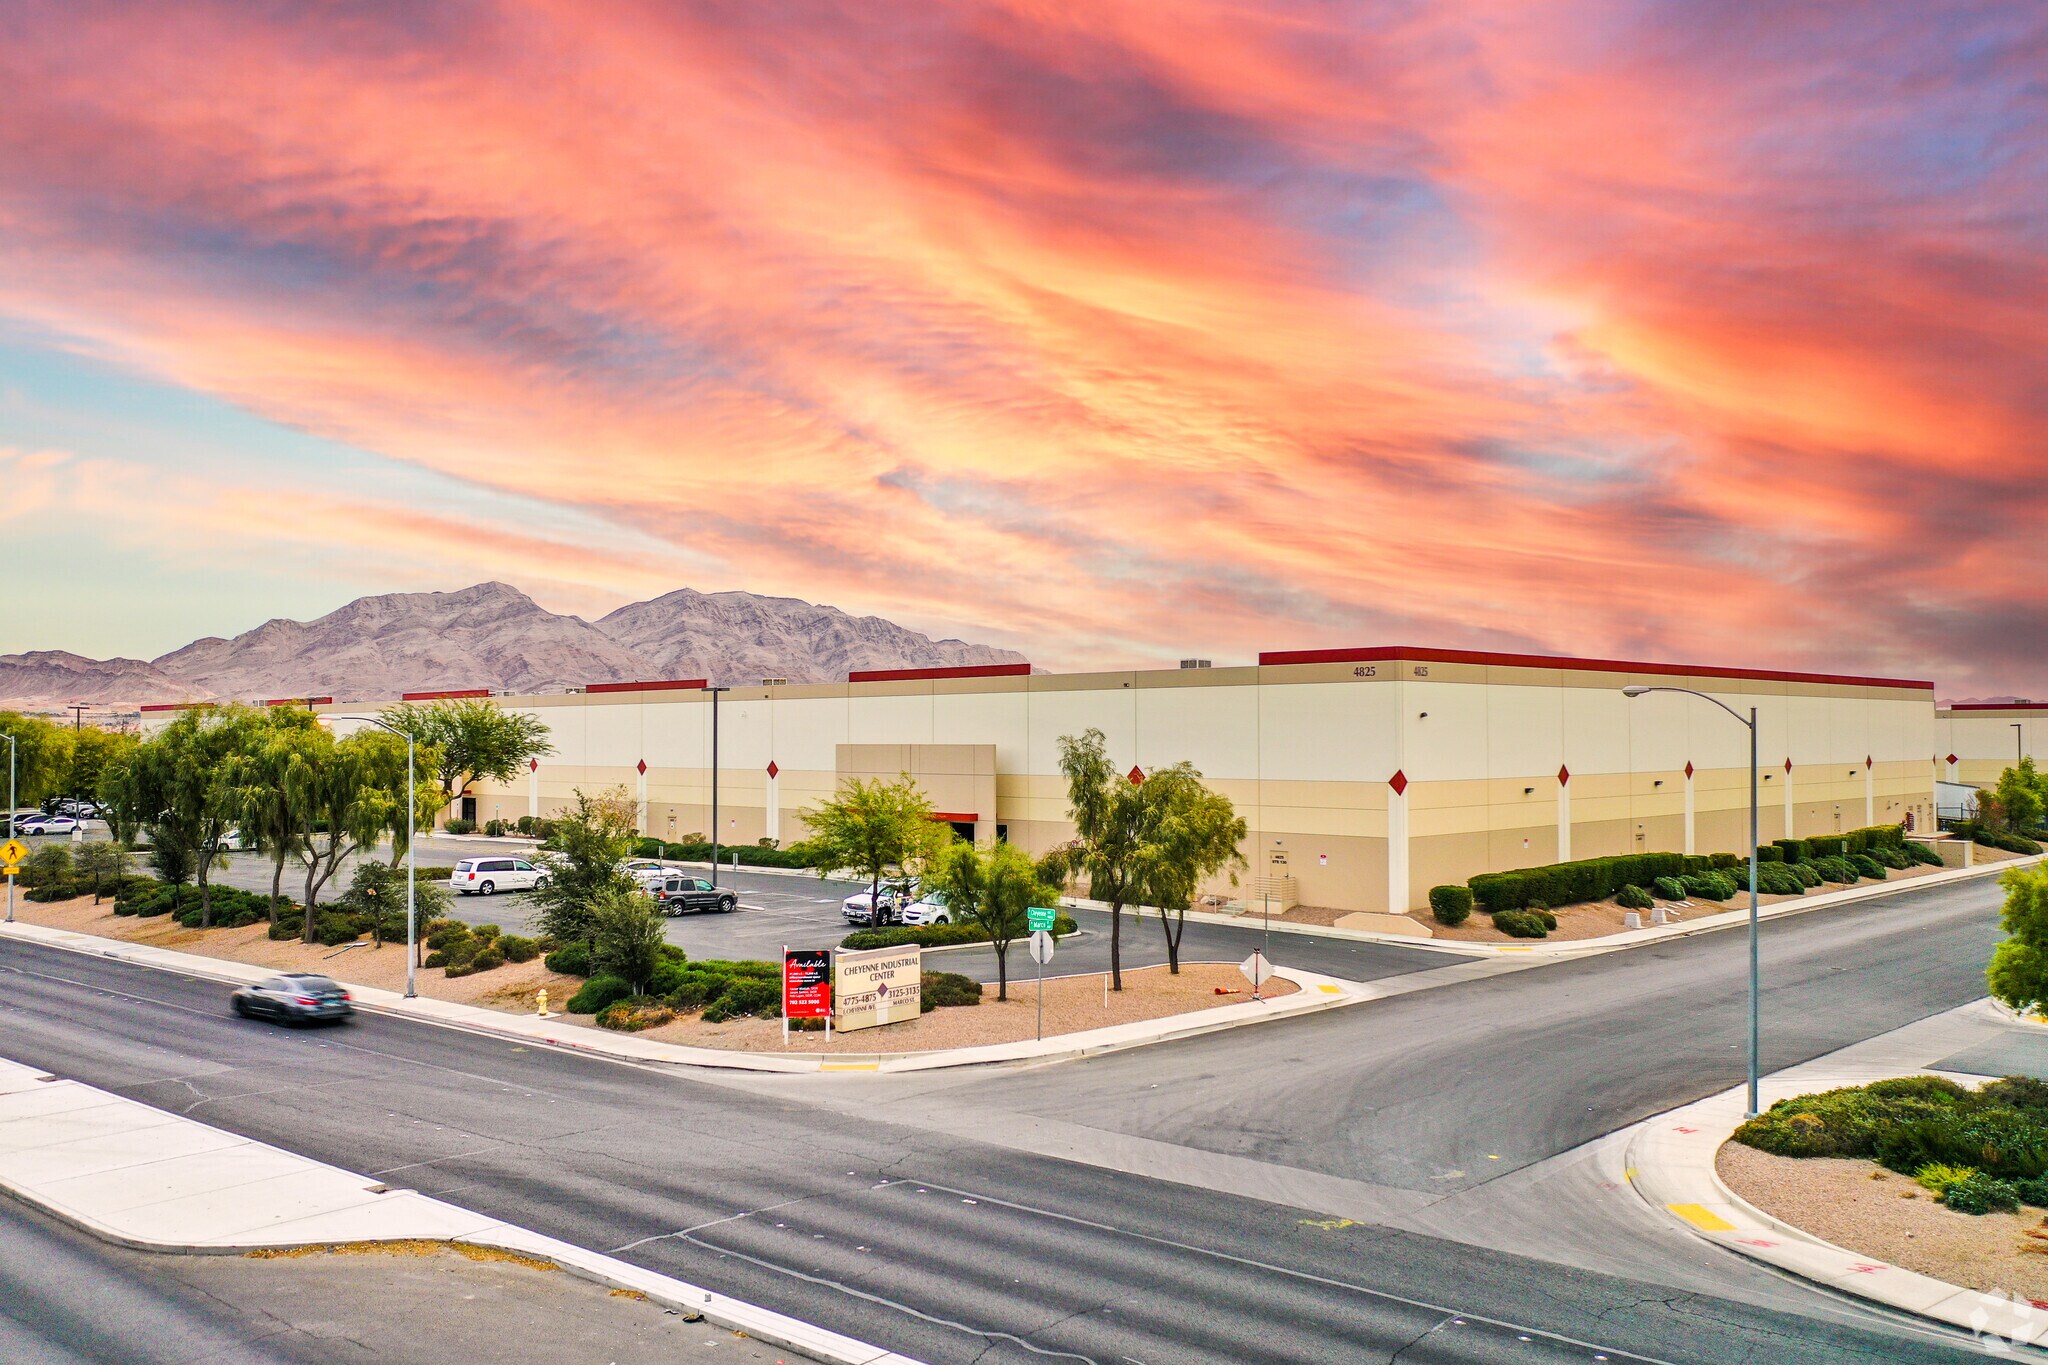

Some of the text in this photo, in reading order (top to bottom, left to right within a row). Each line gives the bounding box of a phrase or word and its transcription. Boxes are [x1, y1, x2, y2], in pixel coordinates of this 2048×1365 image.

[1353, 666, 1376, 677] 4825
[1413, 666, 1429, 677] 4825
[789, 958, 827, 969] Available
[844, 957, 918, 976] CHEYENNE INDUSTRIAL
[870, 970, 894, 981] CENTER
[888, 986, 920, 999] 3125-3135
[843, 993, 877, 1006] 4775-4875
